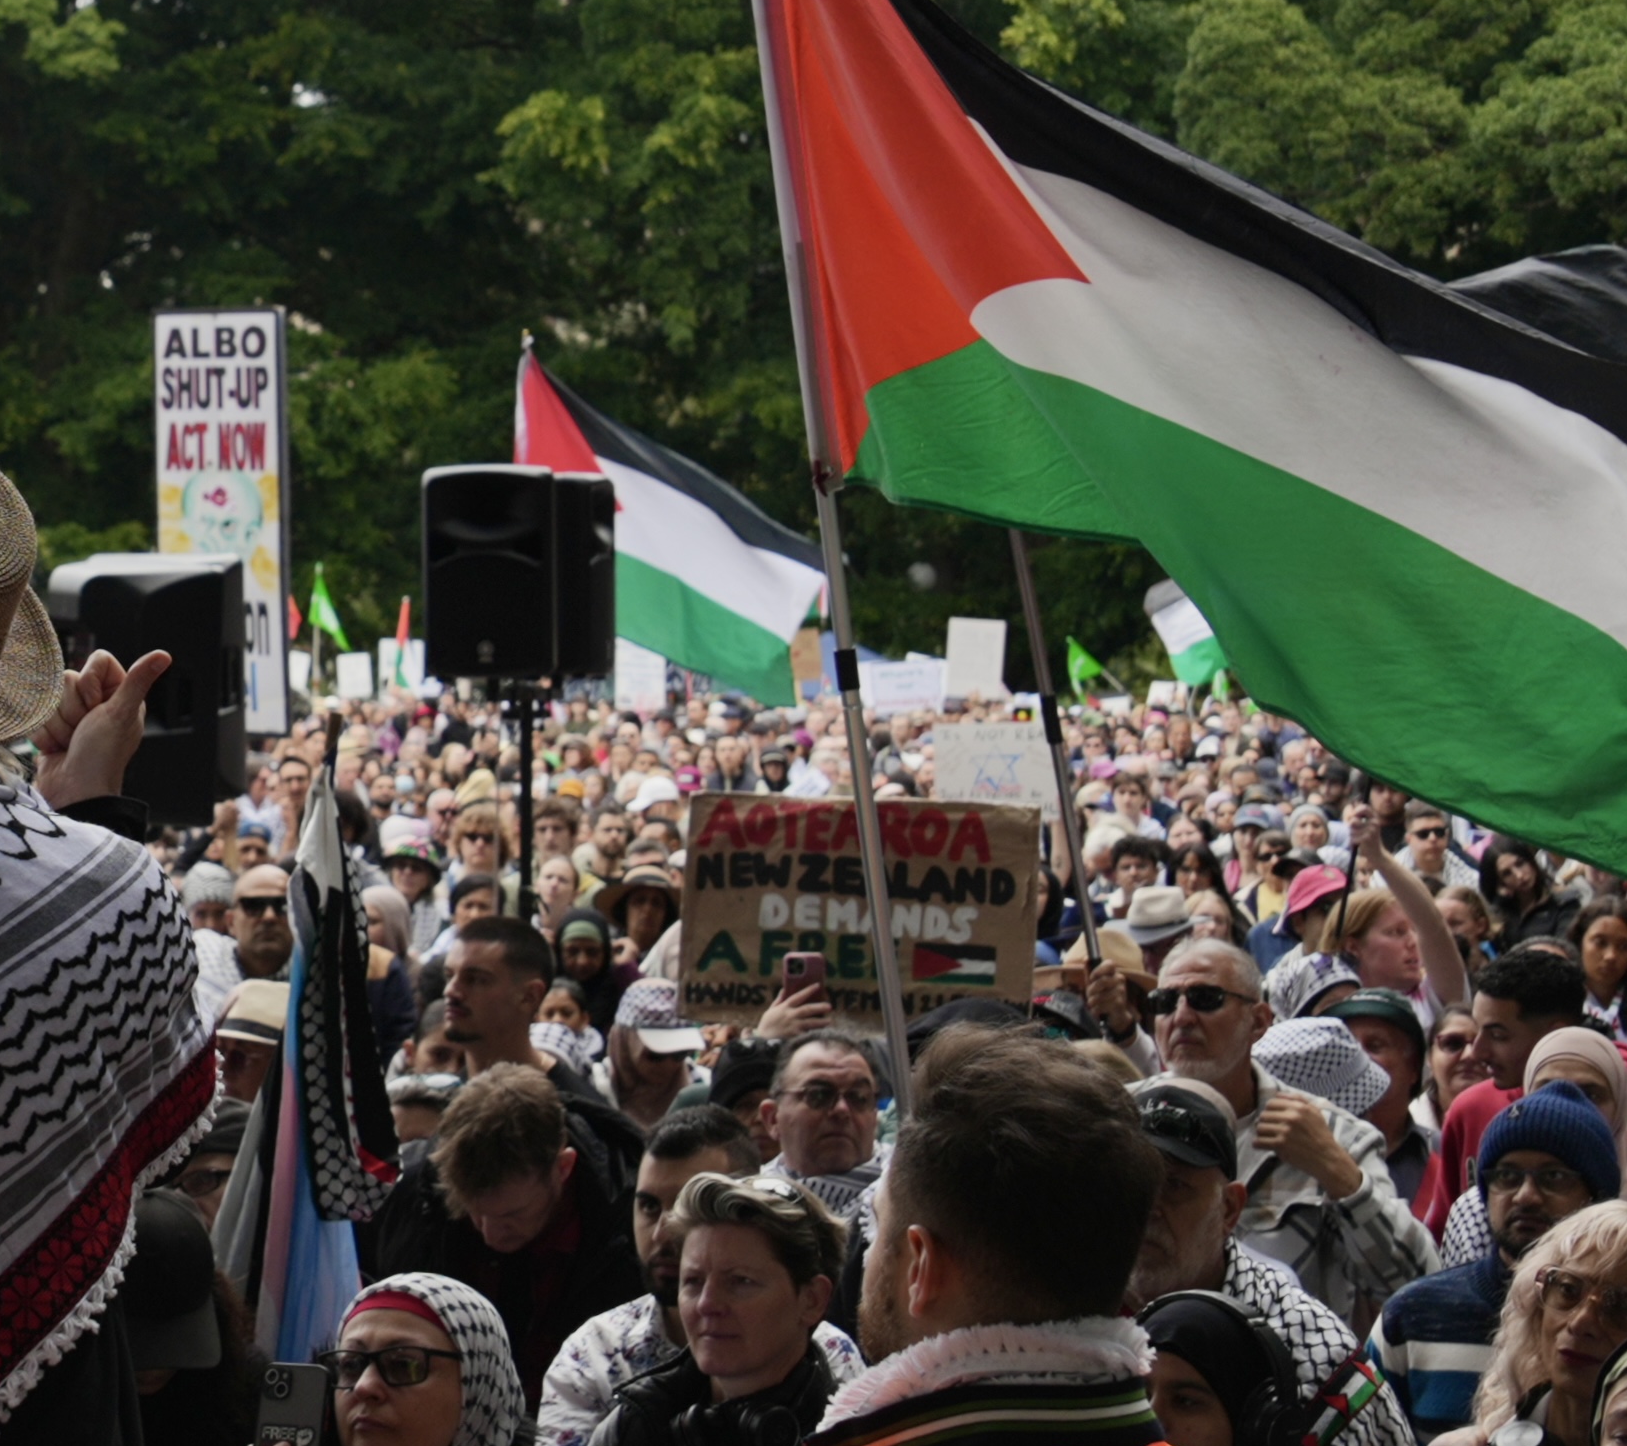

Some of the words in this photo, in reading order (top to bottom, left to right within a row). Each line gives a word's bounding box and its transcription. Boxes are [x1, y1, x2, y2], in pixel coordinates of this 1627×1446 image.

[164, 326, 266, 359] ALBO
[161, 366, 268, 410] SHUT-UP
[219, 422, 266, 471] NOW
[796, 852, 1017, 906] ZELAND
[696, 929, 748, 974] A
[759, 930, 900, 986] FRE
[261, 1425, 297, 1441] FREE
